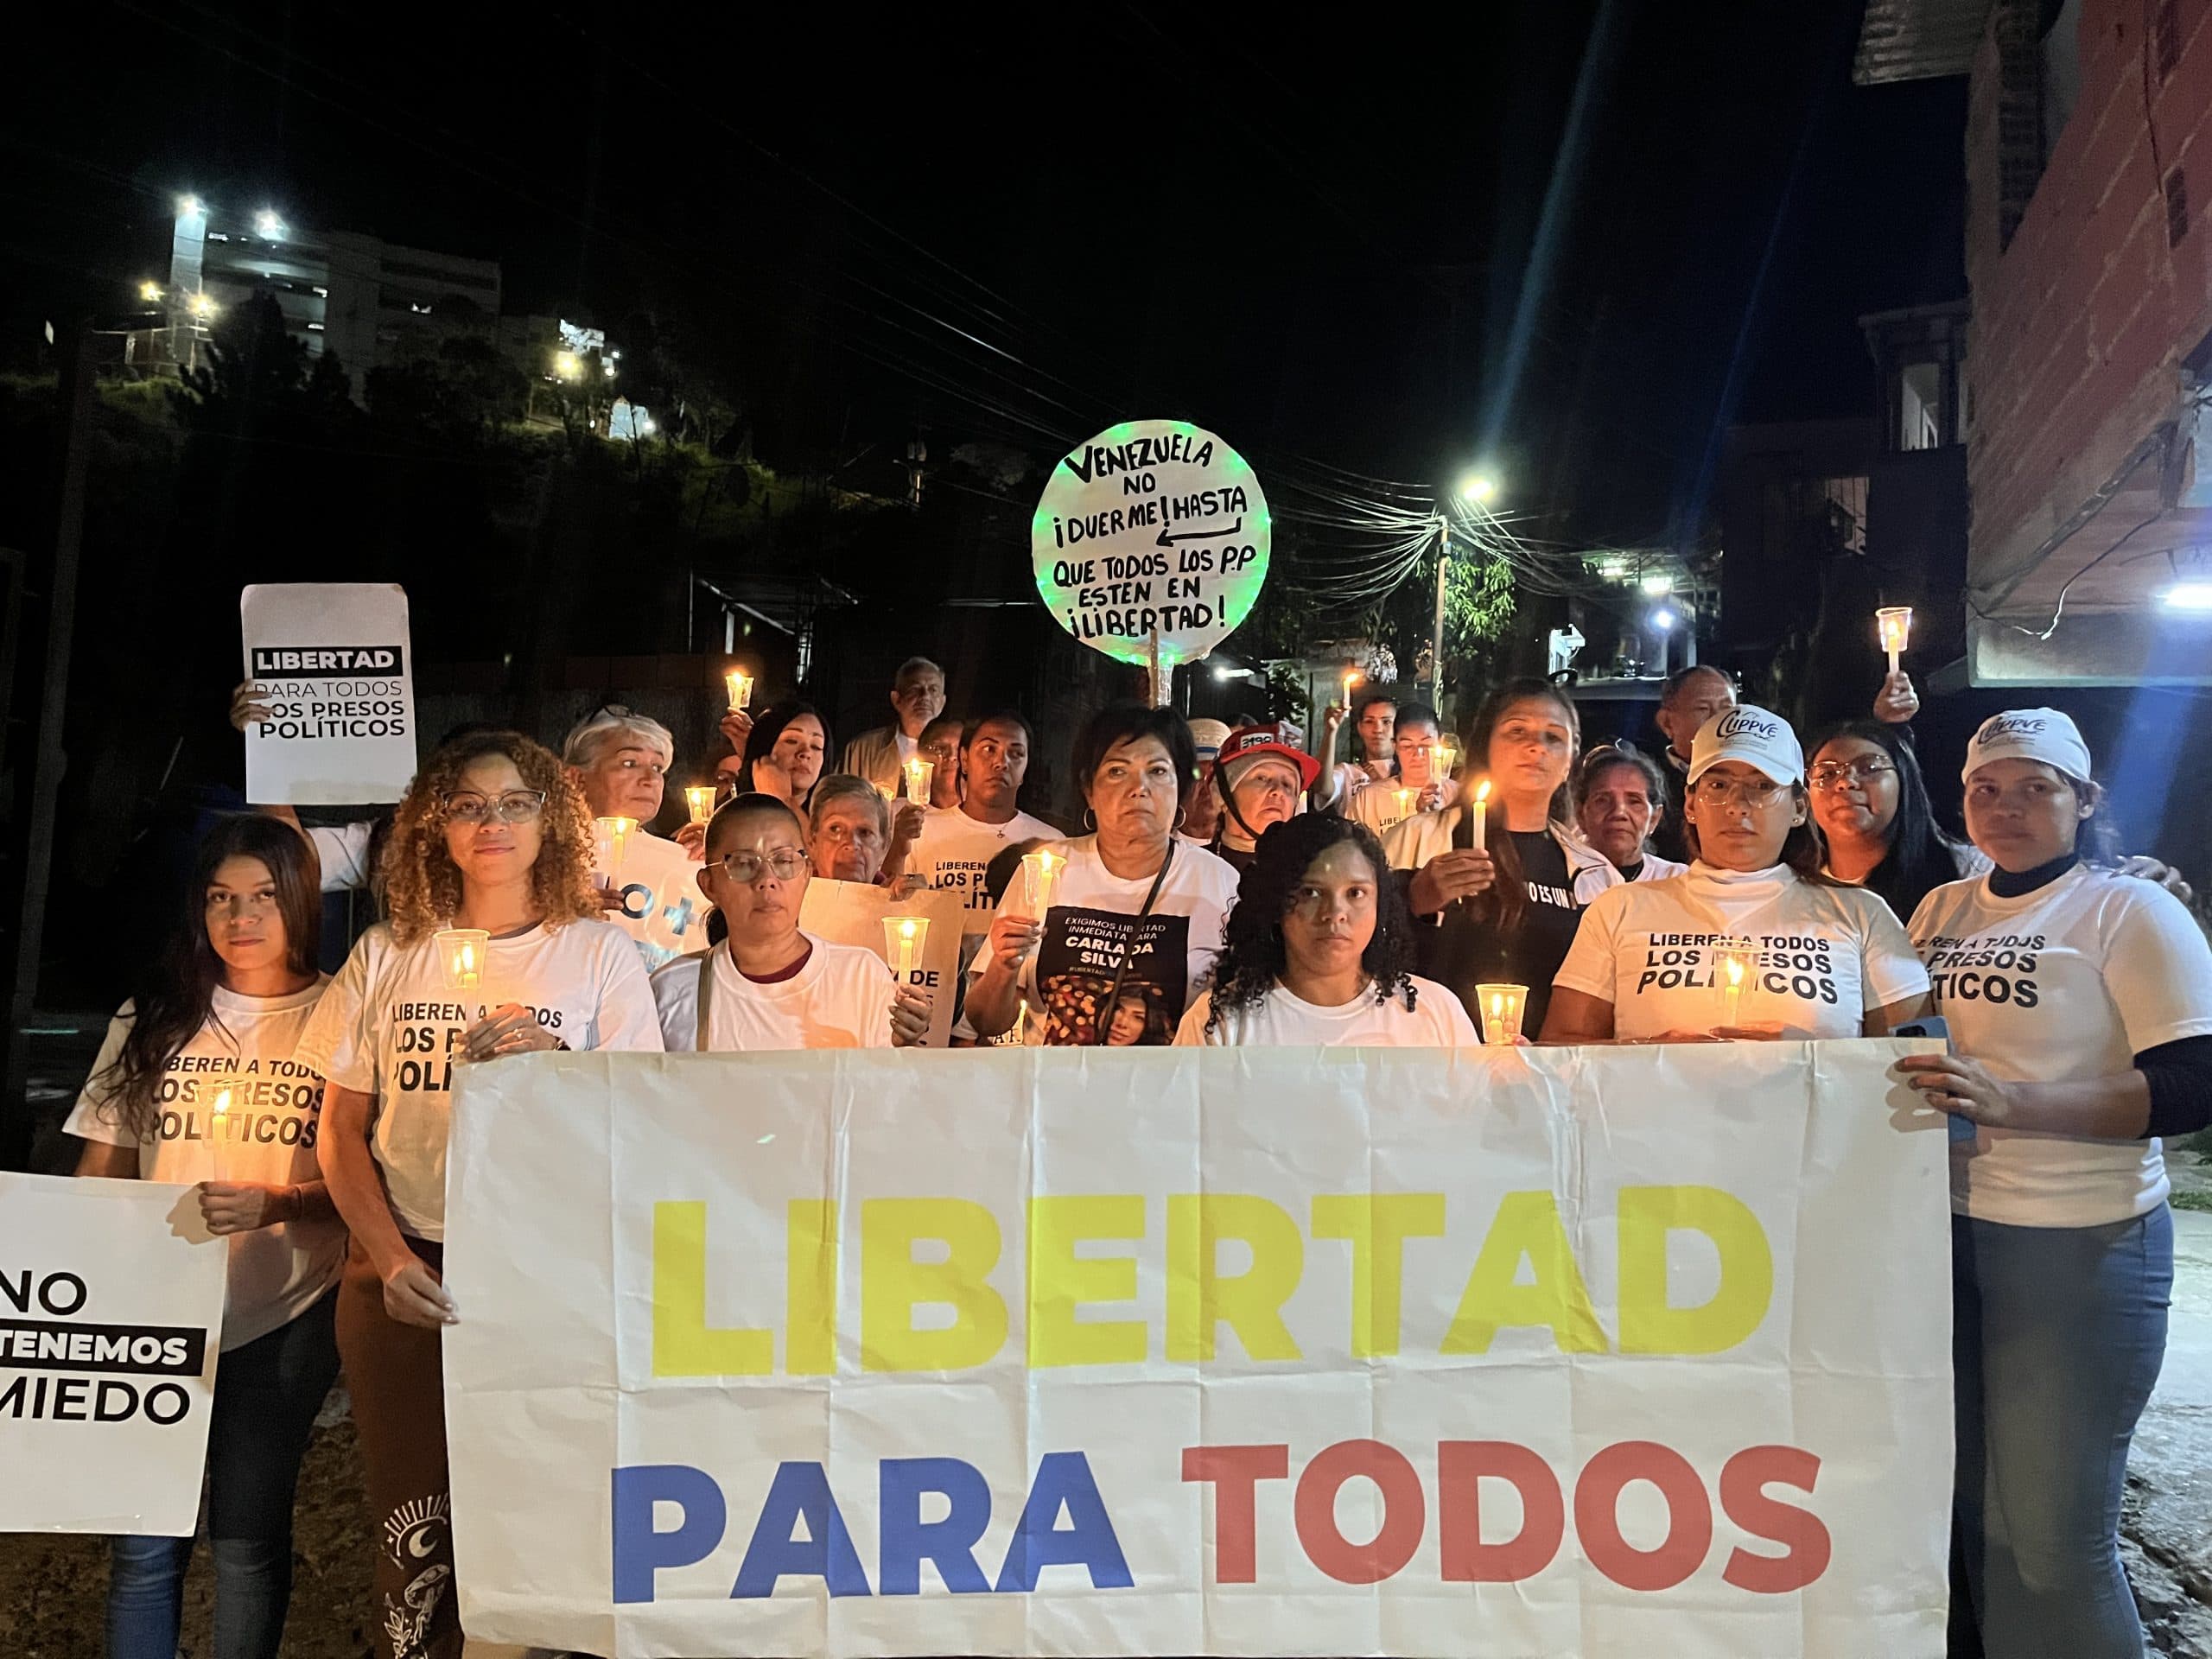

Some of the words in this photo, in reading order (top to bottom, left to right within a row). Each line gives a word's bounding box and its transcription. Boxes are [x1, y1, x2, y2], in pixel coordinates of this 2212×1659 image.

[1064, 434, 1213, 483] VENEZUELA
[1123, 473, 1156, 495] NO
[1173, 486, 1248, 519] HASTA
[1053, 561, 1096, 588] QUE
[1101, 553, 1169, 580] TODOS
[1179, 549, 1212, 573] LOS
[1079, 582, 1151, 607] ESTEN
[1167, 576, 1200, 598] EN
[257, 651, 394, 670] LIBERTAD
[322, 681, 402, 696] TODOS
[270, 702, 302, 718] OS
[312, 701, 404, 717] PRESOS
[260, 716, 405, 739] POLÍTICOS
[936, 861, 986, 871] LIBEREN
[935, 873, 966, 889] LOS
[1065, 917, 1116, 930] EXIGIMOS
[1118, 924, 1166, 933] LIBTAD
[1068, 925, 1127, 941] INMEDIATA
[1135, 932, 1158, 941] ARA
[1065, 936, 1125, 955] CARLA
[1760, 936, 1830, 951] TODOS
[1646, 950, 1701, 968] LOS
[1926, 950, 2039, 973] PRESOS
[392, 1003, 467, 1022] LIBEREN
[167, 1057, 239, 1073] BEREN
[245, 1059, 259, 1074] A
[651, 1183, 1774, 1377] LIBERTAD
[611, 1450, 1135, 1605] PARA
[1182, 1438, 1832, 1593] TODOS
